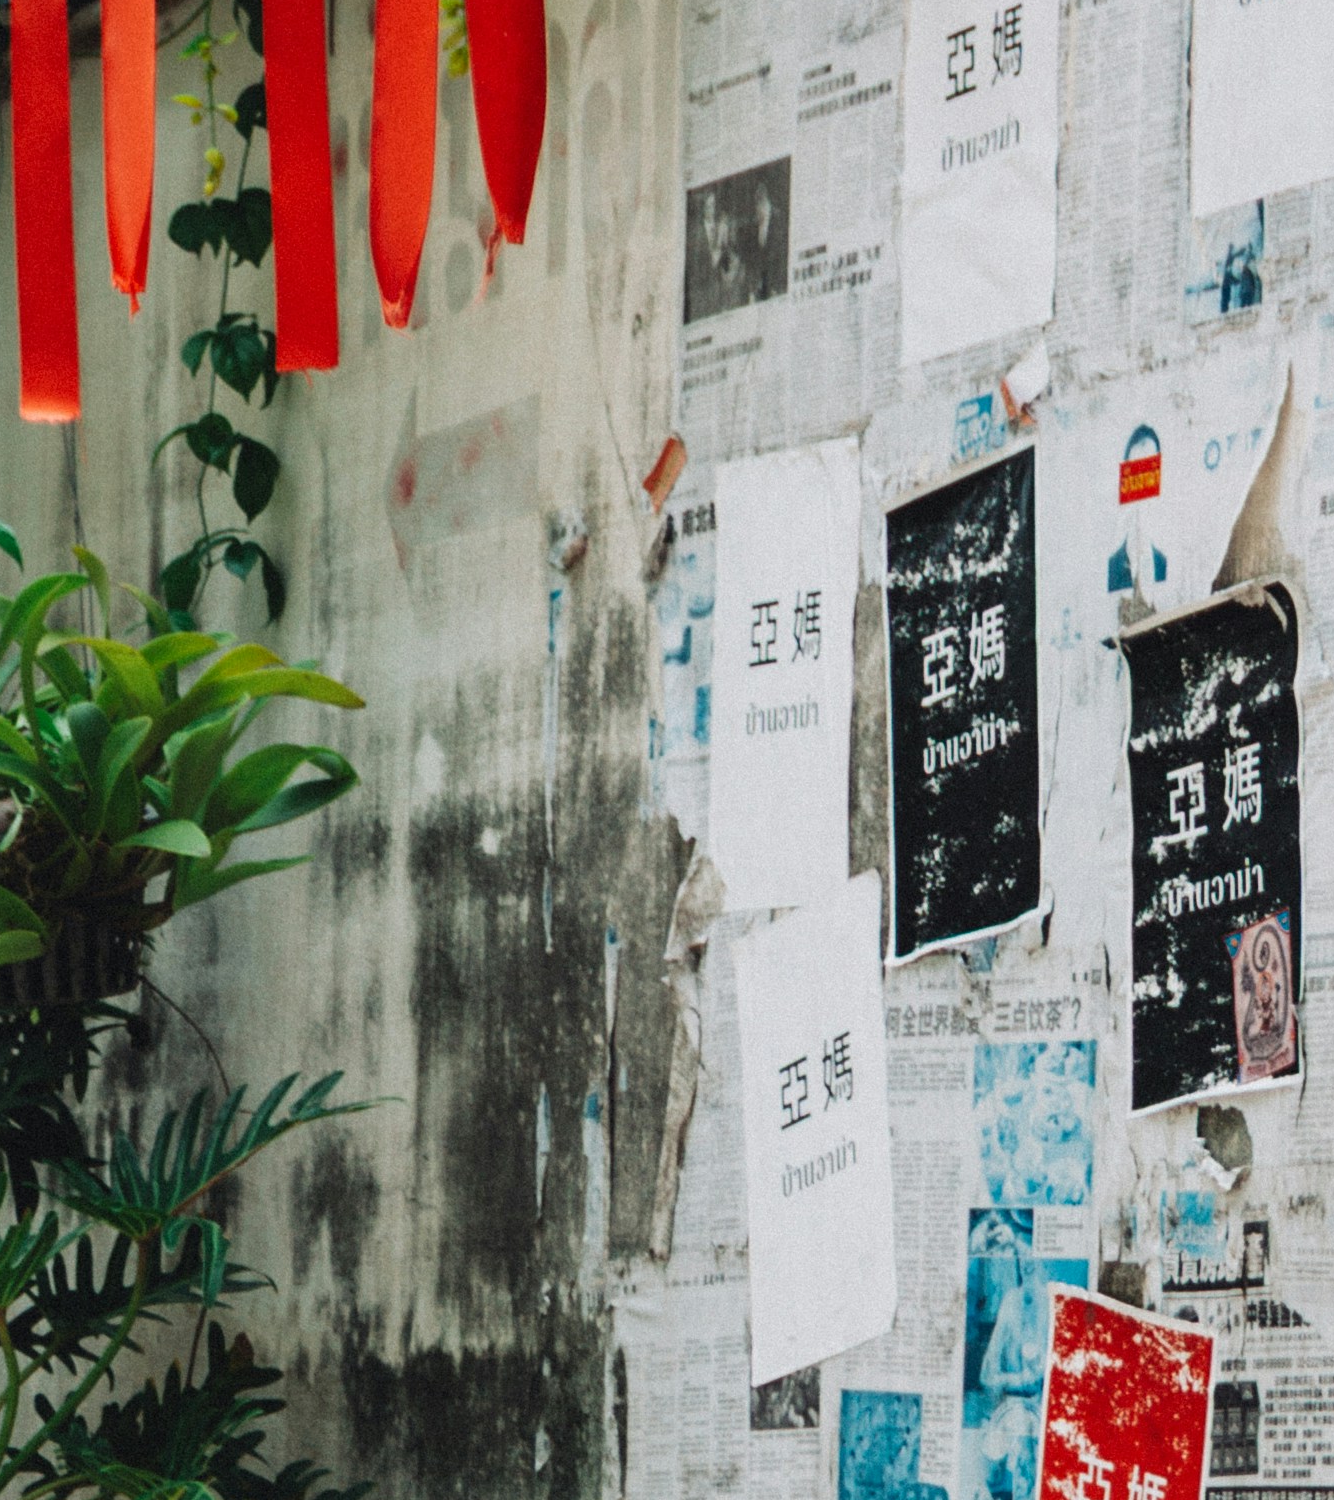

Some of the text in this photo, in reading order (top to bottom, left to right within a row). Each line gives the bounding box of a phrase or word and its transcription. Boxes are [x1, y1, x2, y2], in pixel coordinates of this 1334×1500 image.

[945, 3, 1025, 102] 亞媽
[940, 120, 1022, 173] บ้านอาม่า
[749, 589, 824, 668] 亞媽
[921, 603, 1006, 708] 亞媽
[745, 700, 820, 736] บ้านอาม่า
[922, 714, 1008, 776] บ้านอาม่า
[1164, 742, 1262, 845] 亞媽
[1165, 858, 1265, 917] บ้านอาม่า
[779, 1031, 854, 1132] 亞媽
[780, 1137, 859, 1199] บ้านอาม่า
